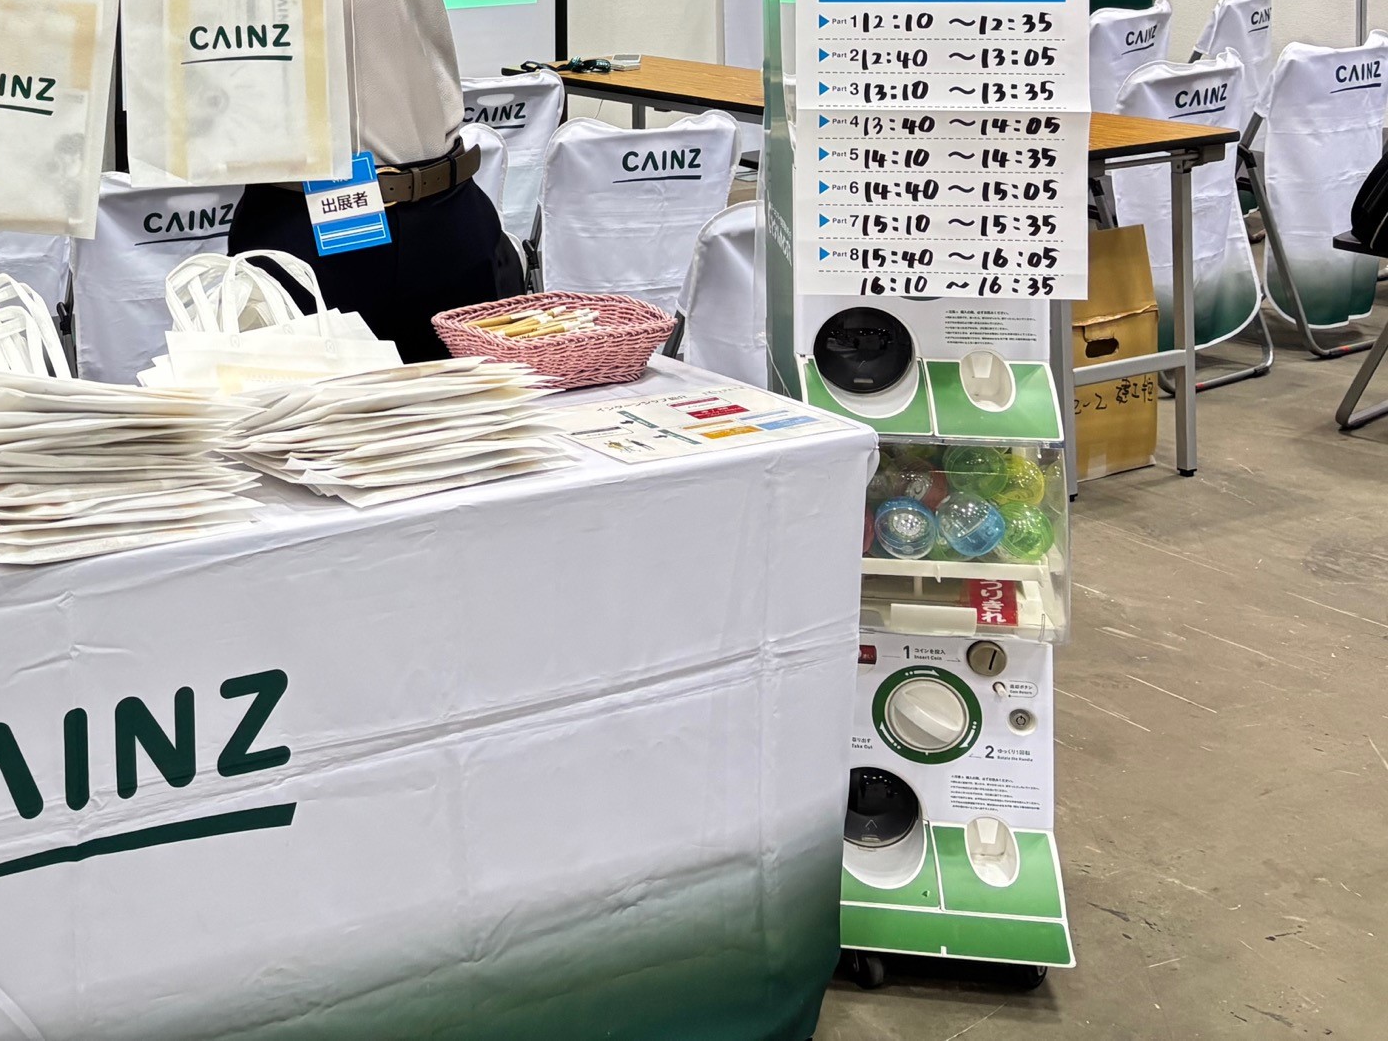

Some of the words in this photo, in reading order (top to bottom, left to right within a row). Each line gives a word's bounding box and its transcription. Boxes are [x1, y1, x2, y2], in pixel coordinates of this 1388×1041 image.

[850, 15, 857, 28] 1
[189, 23, 292, 51] CAINZ
[849, 49, 859, 61] 2
[1335, 60, 1382, 83] CAINZ
[849, 83, 859, 95] 3
[1174, 82, 1228, 109] CAINZ
[463, 102, 526, 123] CAINZ
[849, 115, 859, 128] 4
[621, 148, 702, 173] CAINZ
[849, 148, 859, 160] 5
[849, 181, 859, 194] 6
[321, 190, 368, 215] 出展者
[143, 203, 234, 234] CAINZ
[849, 215, 859, 227] 7
[849, 248, 859, 261] 8
[903, 645, 911, 659] 1
[985, 745, 994, 760] 2
